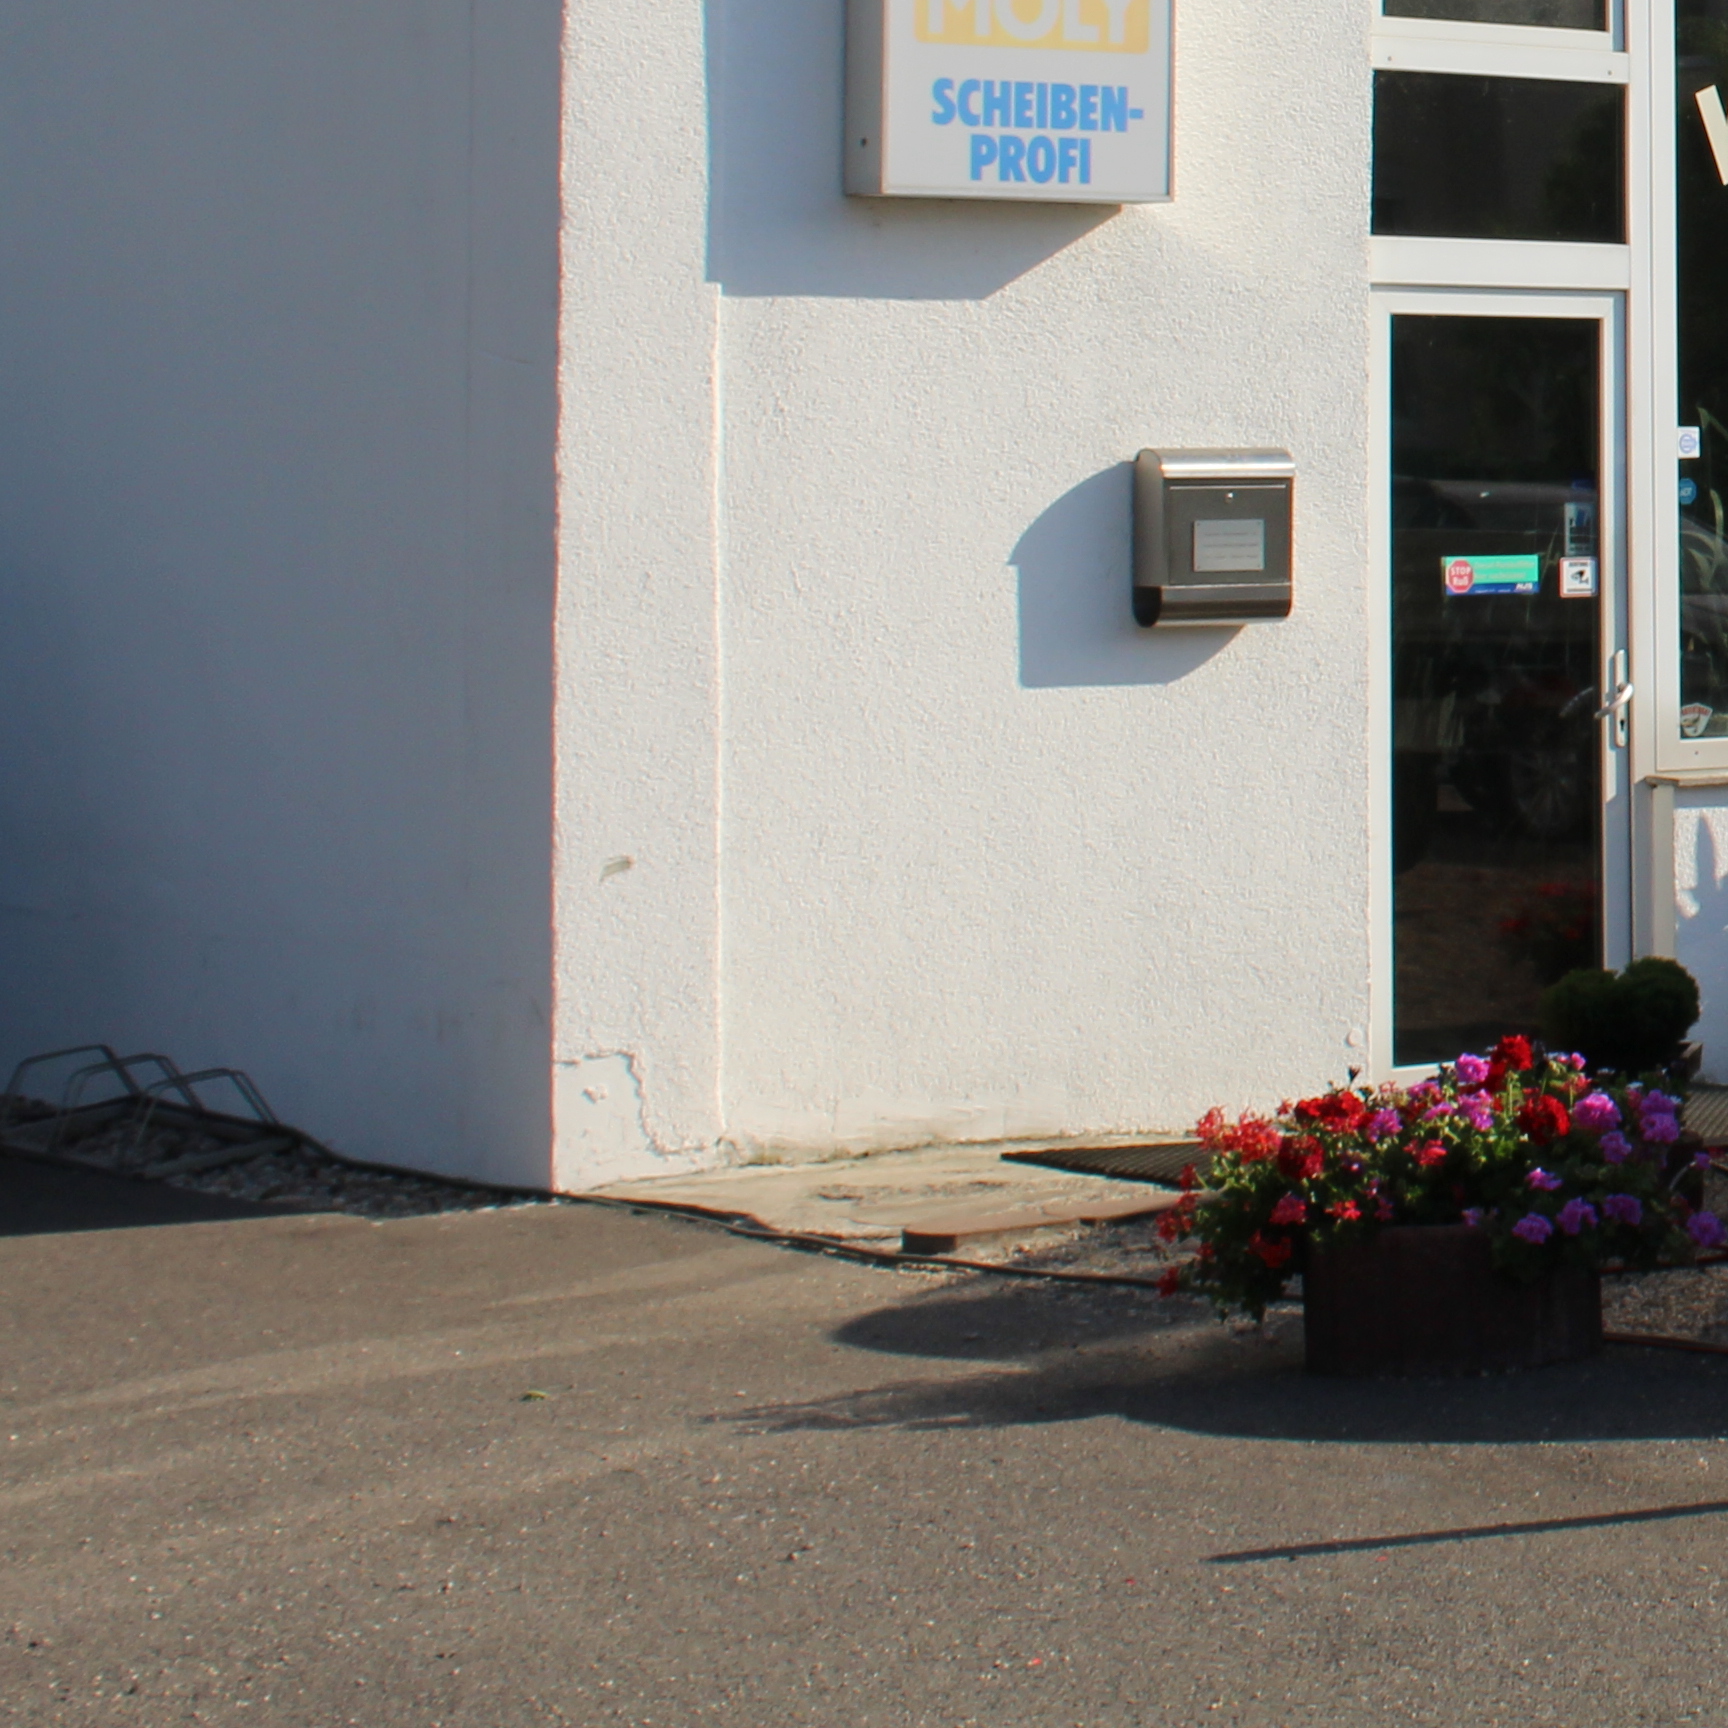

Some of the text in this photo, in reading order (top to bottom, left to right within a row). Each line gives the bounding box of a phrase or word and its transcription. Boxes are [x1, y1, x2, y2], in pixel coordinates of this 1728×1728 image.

[931, 78, 1144, 132] SCHEIBEN-
[969, 134, 1091, 184] PROFI
[1450, 566, 1471, 575] STOP
